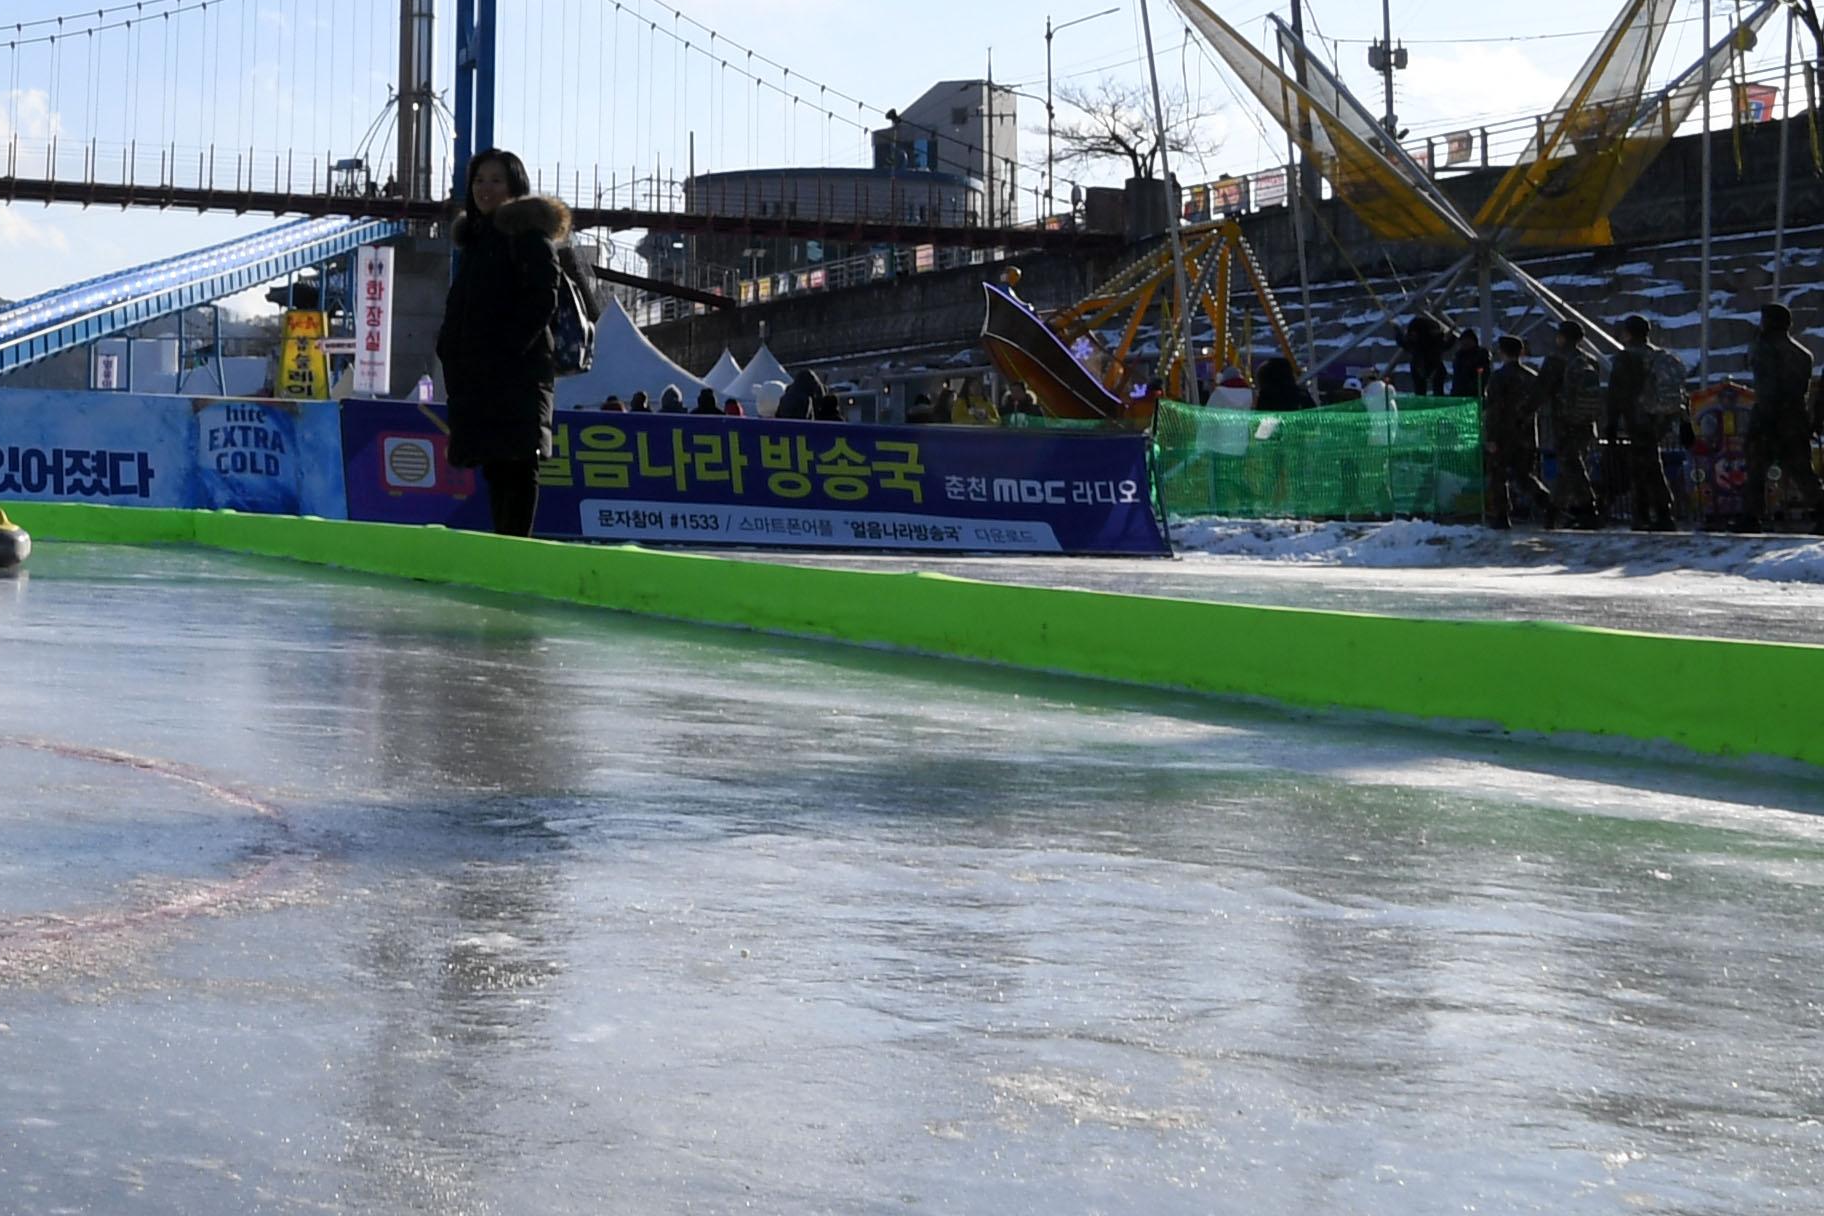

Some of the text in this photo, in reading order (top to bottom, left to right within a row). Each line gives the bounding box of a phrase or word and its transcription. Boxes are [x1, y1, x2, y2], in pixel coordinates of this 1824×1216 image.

[364, 280, 384, 352] 화장실
[224, 404, 266, 424] hite
[208, 425, 285, 454] EXTRA
[215, 451, 281, 477] COLD
[760, 434, 927, 503] 방송국
[944, 475, 1141, 505] 춘천 MBC 라디오
[597, 509, 664, 530] 문자참여
[670, 513, 719, 531] #1533
[738, 515, 833, 538] 스마트폰어플
[973, 527, 1038, 545] 다운로드
